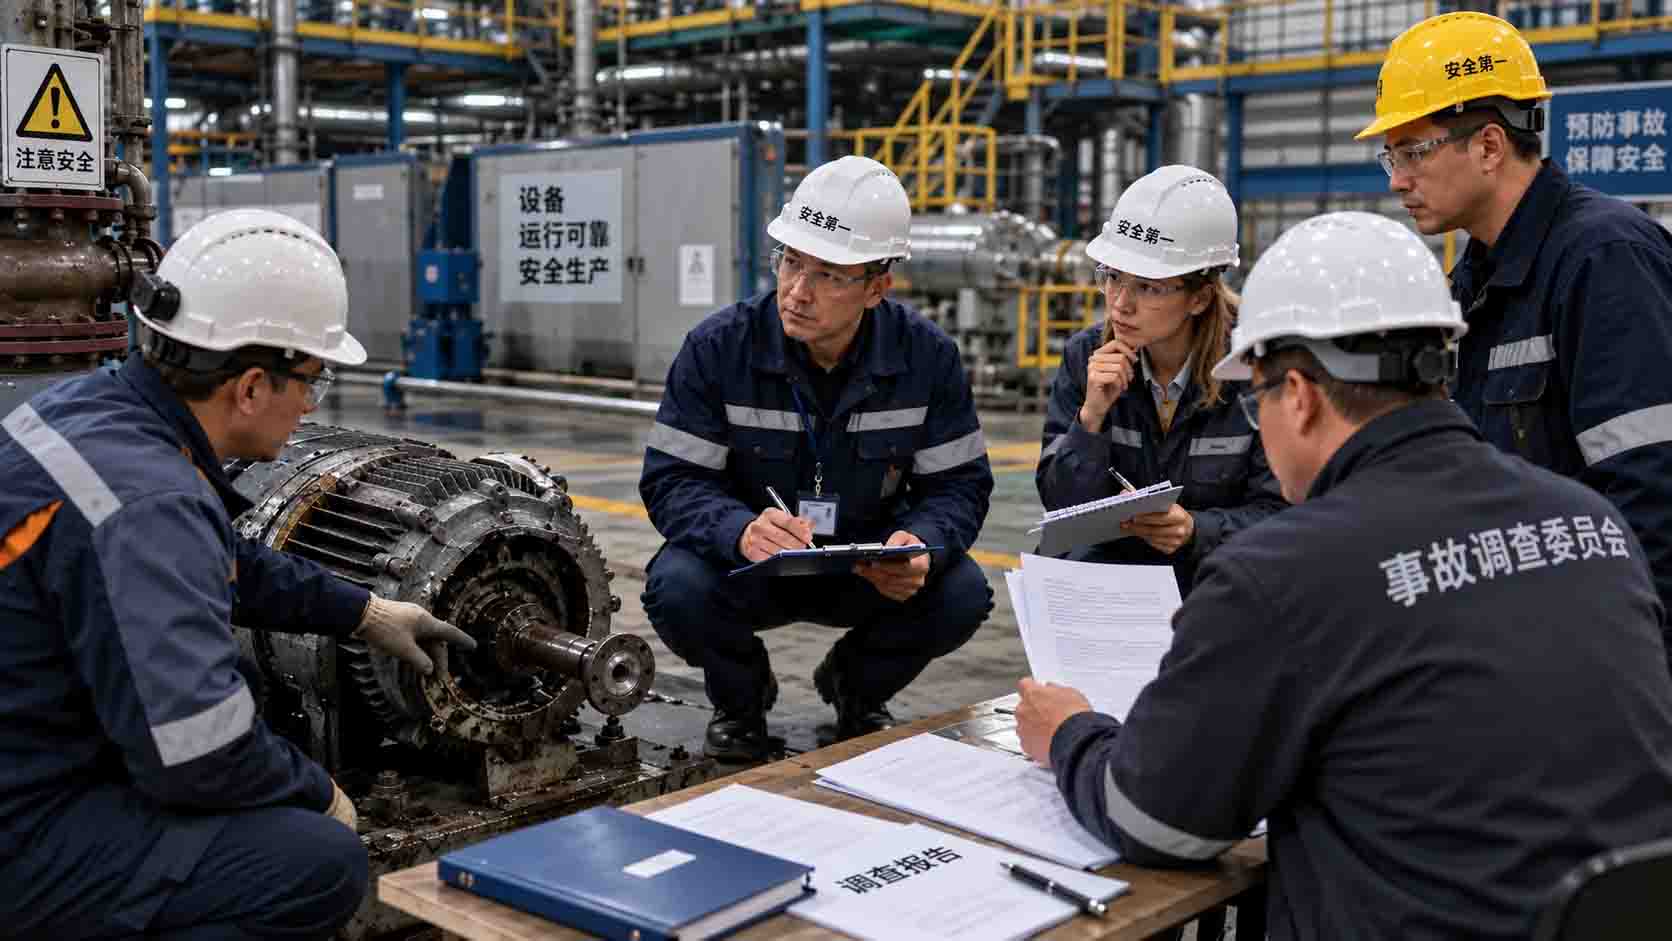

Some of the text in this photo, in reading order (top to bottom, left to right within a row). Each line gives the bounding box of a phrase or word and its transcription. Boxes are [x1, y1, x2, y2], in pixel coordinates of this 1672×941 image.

[1444, 54, 1508, 80] 安全第一
[1566, 109, 1666, 139] 预防事故
[15, 147, 95, 173] 注意安全
[1566, 144, 1666, 174] 保障安全
[519, 185, 565, 214] 设备
[519, 219, 609, 249] 运行可靠
[799, 206, 851, 232] 安全第一
[1116, 219, 1174, 245] 安全第一
[519, 256, 609, 286] 安全生产
[1379, 515, 1631, 607] 事故调查委员会
[835, 846, 963, 895] 调查报告
